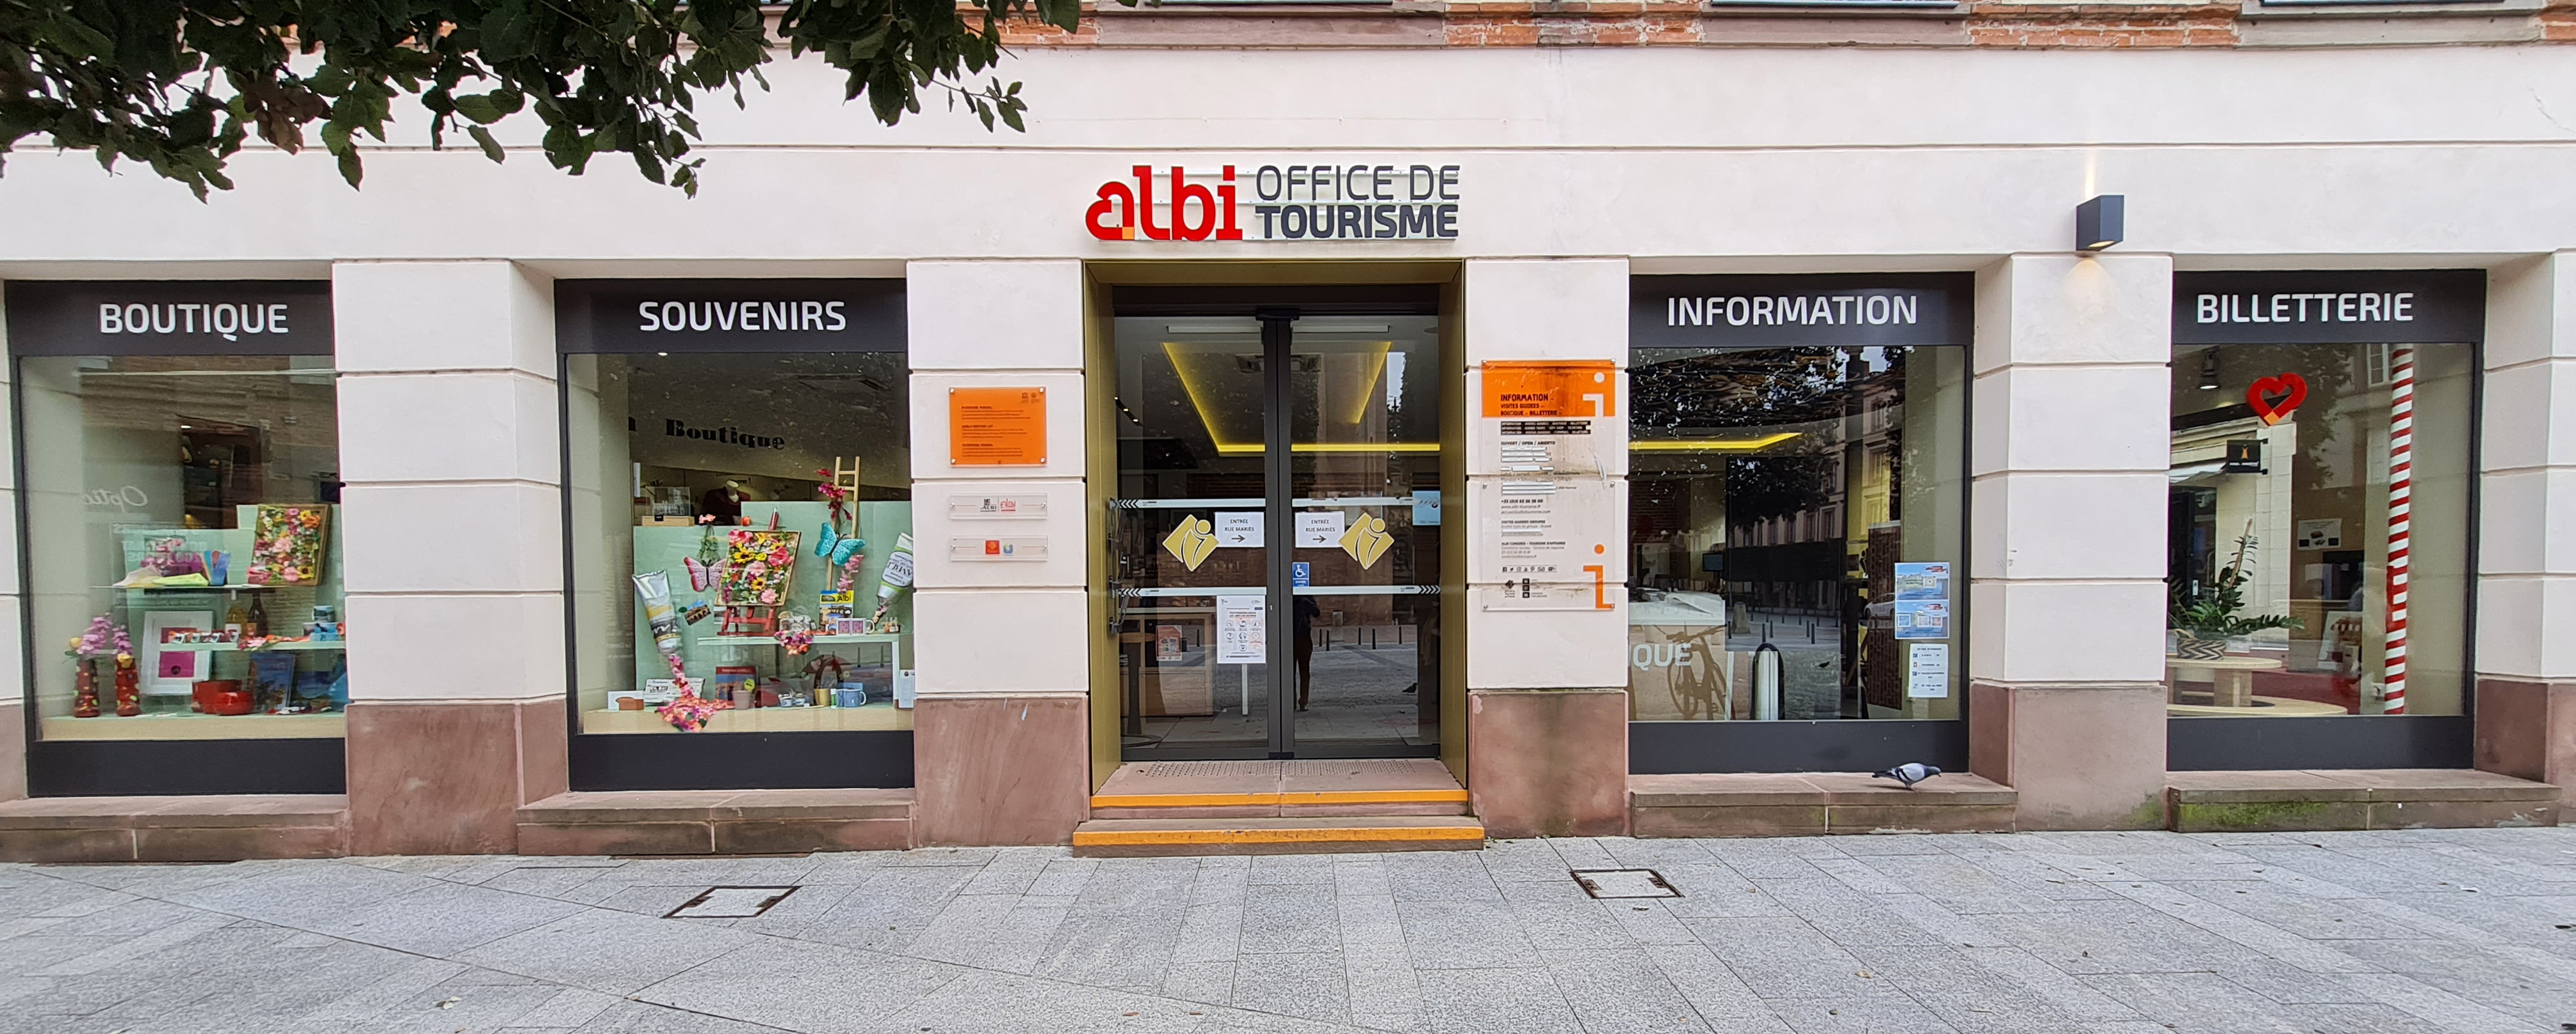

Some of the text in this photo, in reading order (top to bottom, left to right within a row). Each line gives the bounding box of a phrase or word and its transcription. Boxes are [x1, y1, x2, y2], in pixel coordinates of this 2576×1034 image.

[1255, 165, 1460, 201] OFFICE DE
[1085, 165, 1243, 242] albi
[1255, 204, 1459, 239] TOURISME
[100, 303, 289, 342] BOUTIQUE
[639, 301, 847, 331] SOUVENIRS
[1667, 295, 1918, 327] INFORMATION
[2196, 292, 2414, 324] BILLETTERIE
[665, 418, 785, 451] Boutique
